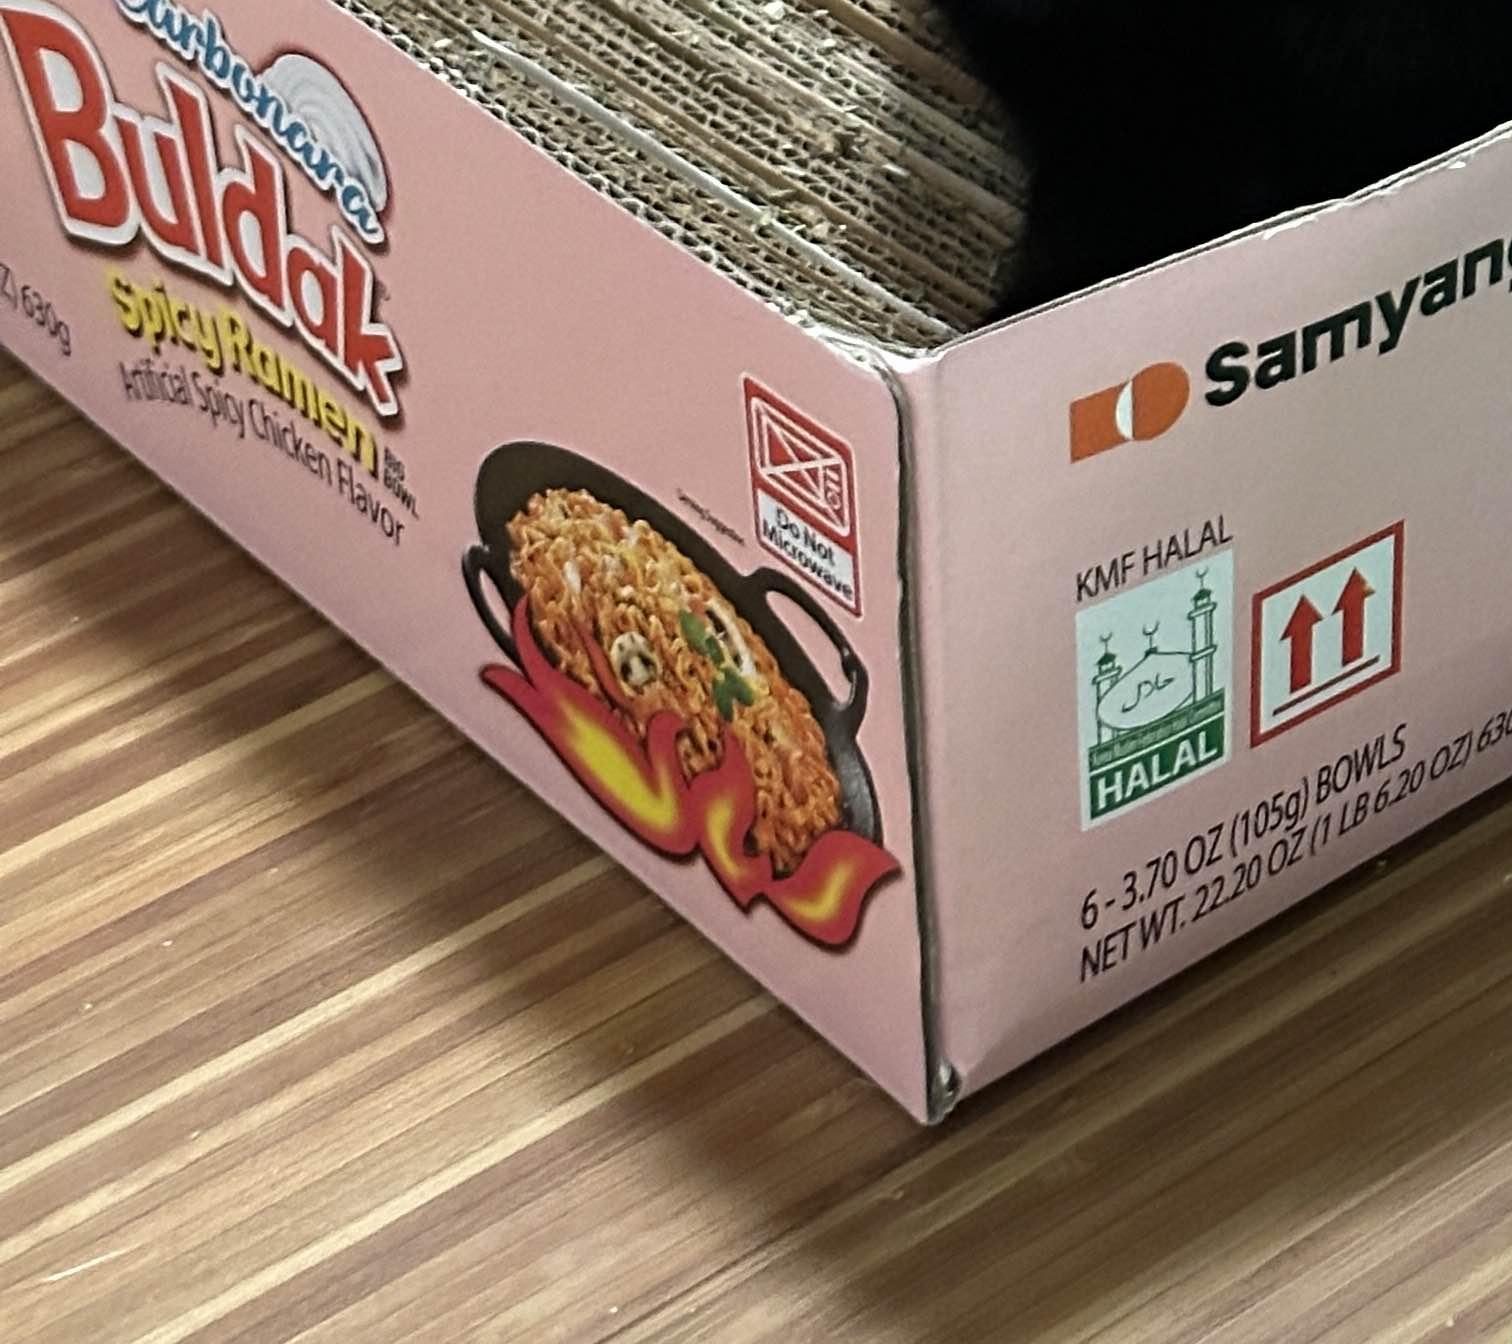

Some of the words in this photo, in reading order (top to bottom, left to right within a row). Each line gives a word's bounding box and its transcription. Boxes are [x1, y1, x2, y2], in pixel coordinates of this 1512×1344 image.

[0, 0, 400, 410] Buldak
[21, 284, 72, 357] 630g
[108, 267, 224, 376] Spicy
[220, 304, 380, 479] Ramen
[119, 358, 194, 404] Artificial
[192, 370, 245, 439] Spicy
[249, 398, 333, 487] Chicken
[336, 457, 405, 547] Flavor
[762, 518, 854, 599] Microwave
[776, 507, 800, 540] Do
[802, 529, 837, 568] Not
[1076, 550, 1135, 602] KMF
[1142, 514, 1233, 576] HALAL
[1081, 890, 1099, 931] 6
[1121, 854, 1178, 912] 3.70
[1184, 822, 1224, 877] OZ
[1230, 775, 1309, 858] (105g)
[1316, 723, 1407, 805] BOWLS
[1098, 731, 1218, 810] HALAL
[1080, 925, 1137, 983] NET
[1139, 894, 1187, 947] WT.
[1192, 854, 1263, 922] 22.20
[1267, 828, 1305, 878] OZ
[1309, 815, 1332, 857] (1
[1339, 794, 1374, 838] LB
[1374, 758, 1426, 815] 6.20
[1429, 732, 1475, 782] OZ)
